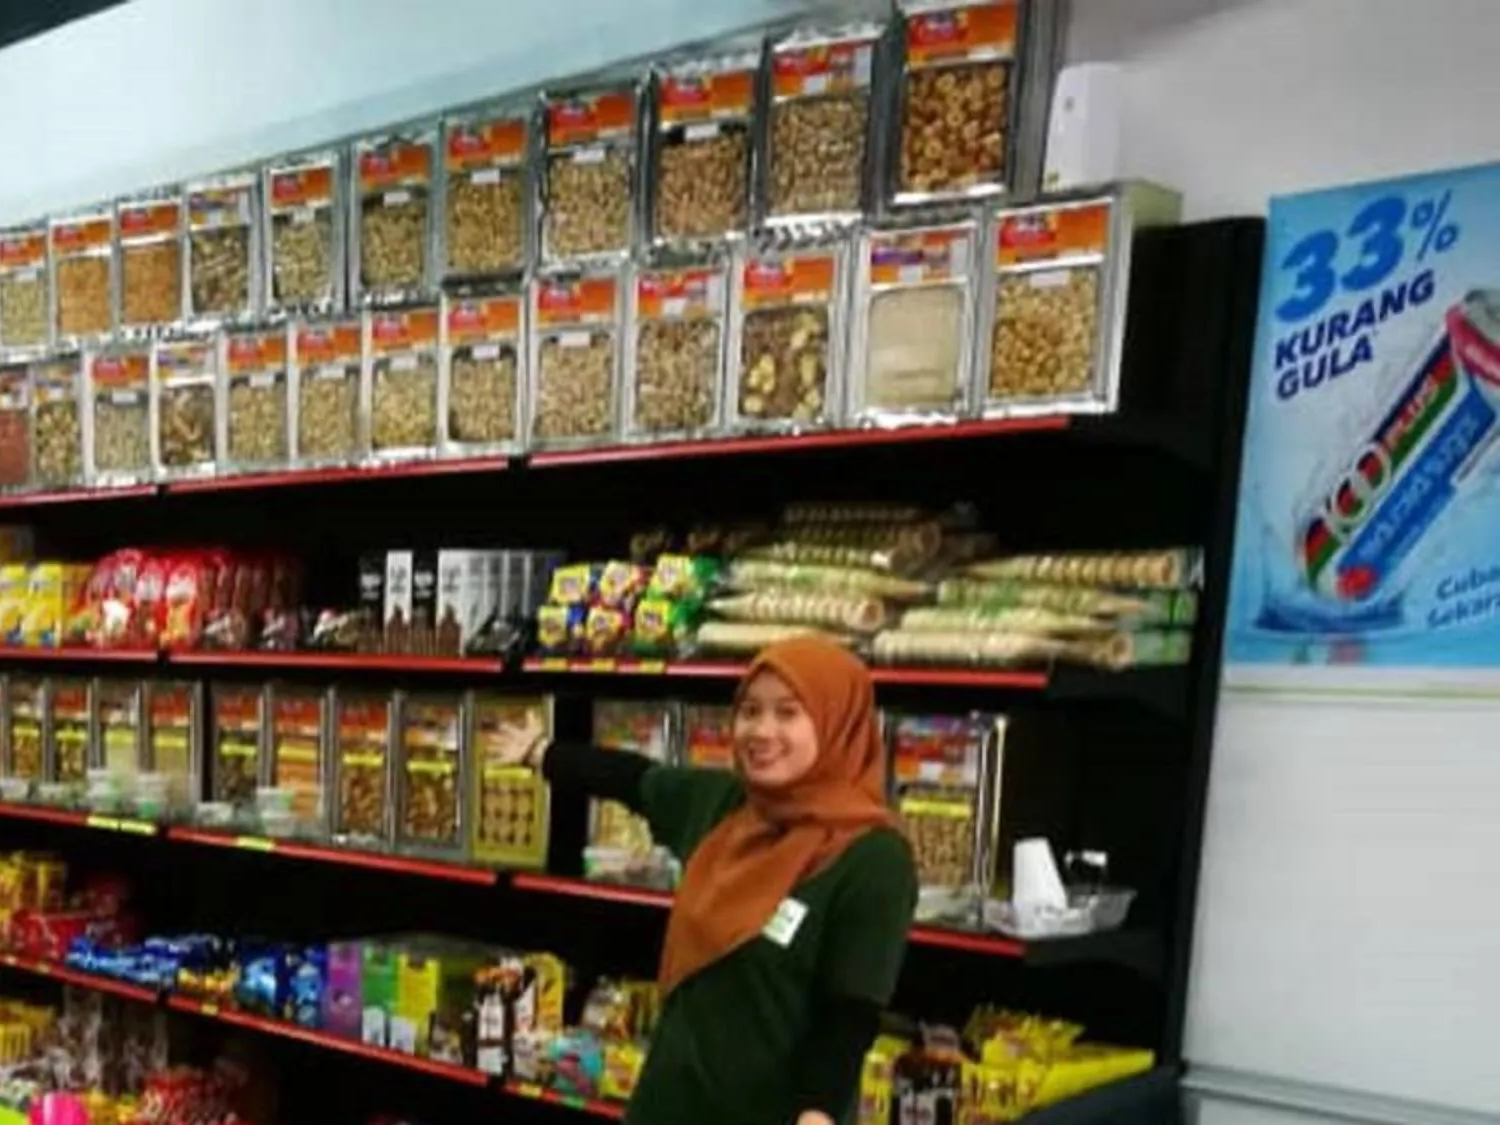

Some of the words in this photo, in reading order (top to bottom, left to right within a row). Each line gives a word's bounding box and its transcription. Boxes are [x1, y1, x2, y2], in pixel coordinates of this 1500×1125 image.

[1275, 188, 1460, 323] 33%
[1274, 268, 1435, 370] KURANG
[1276, 334, 1374, 400] GULA
